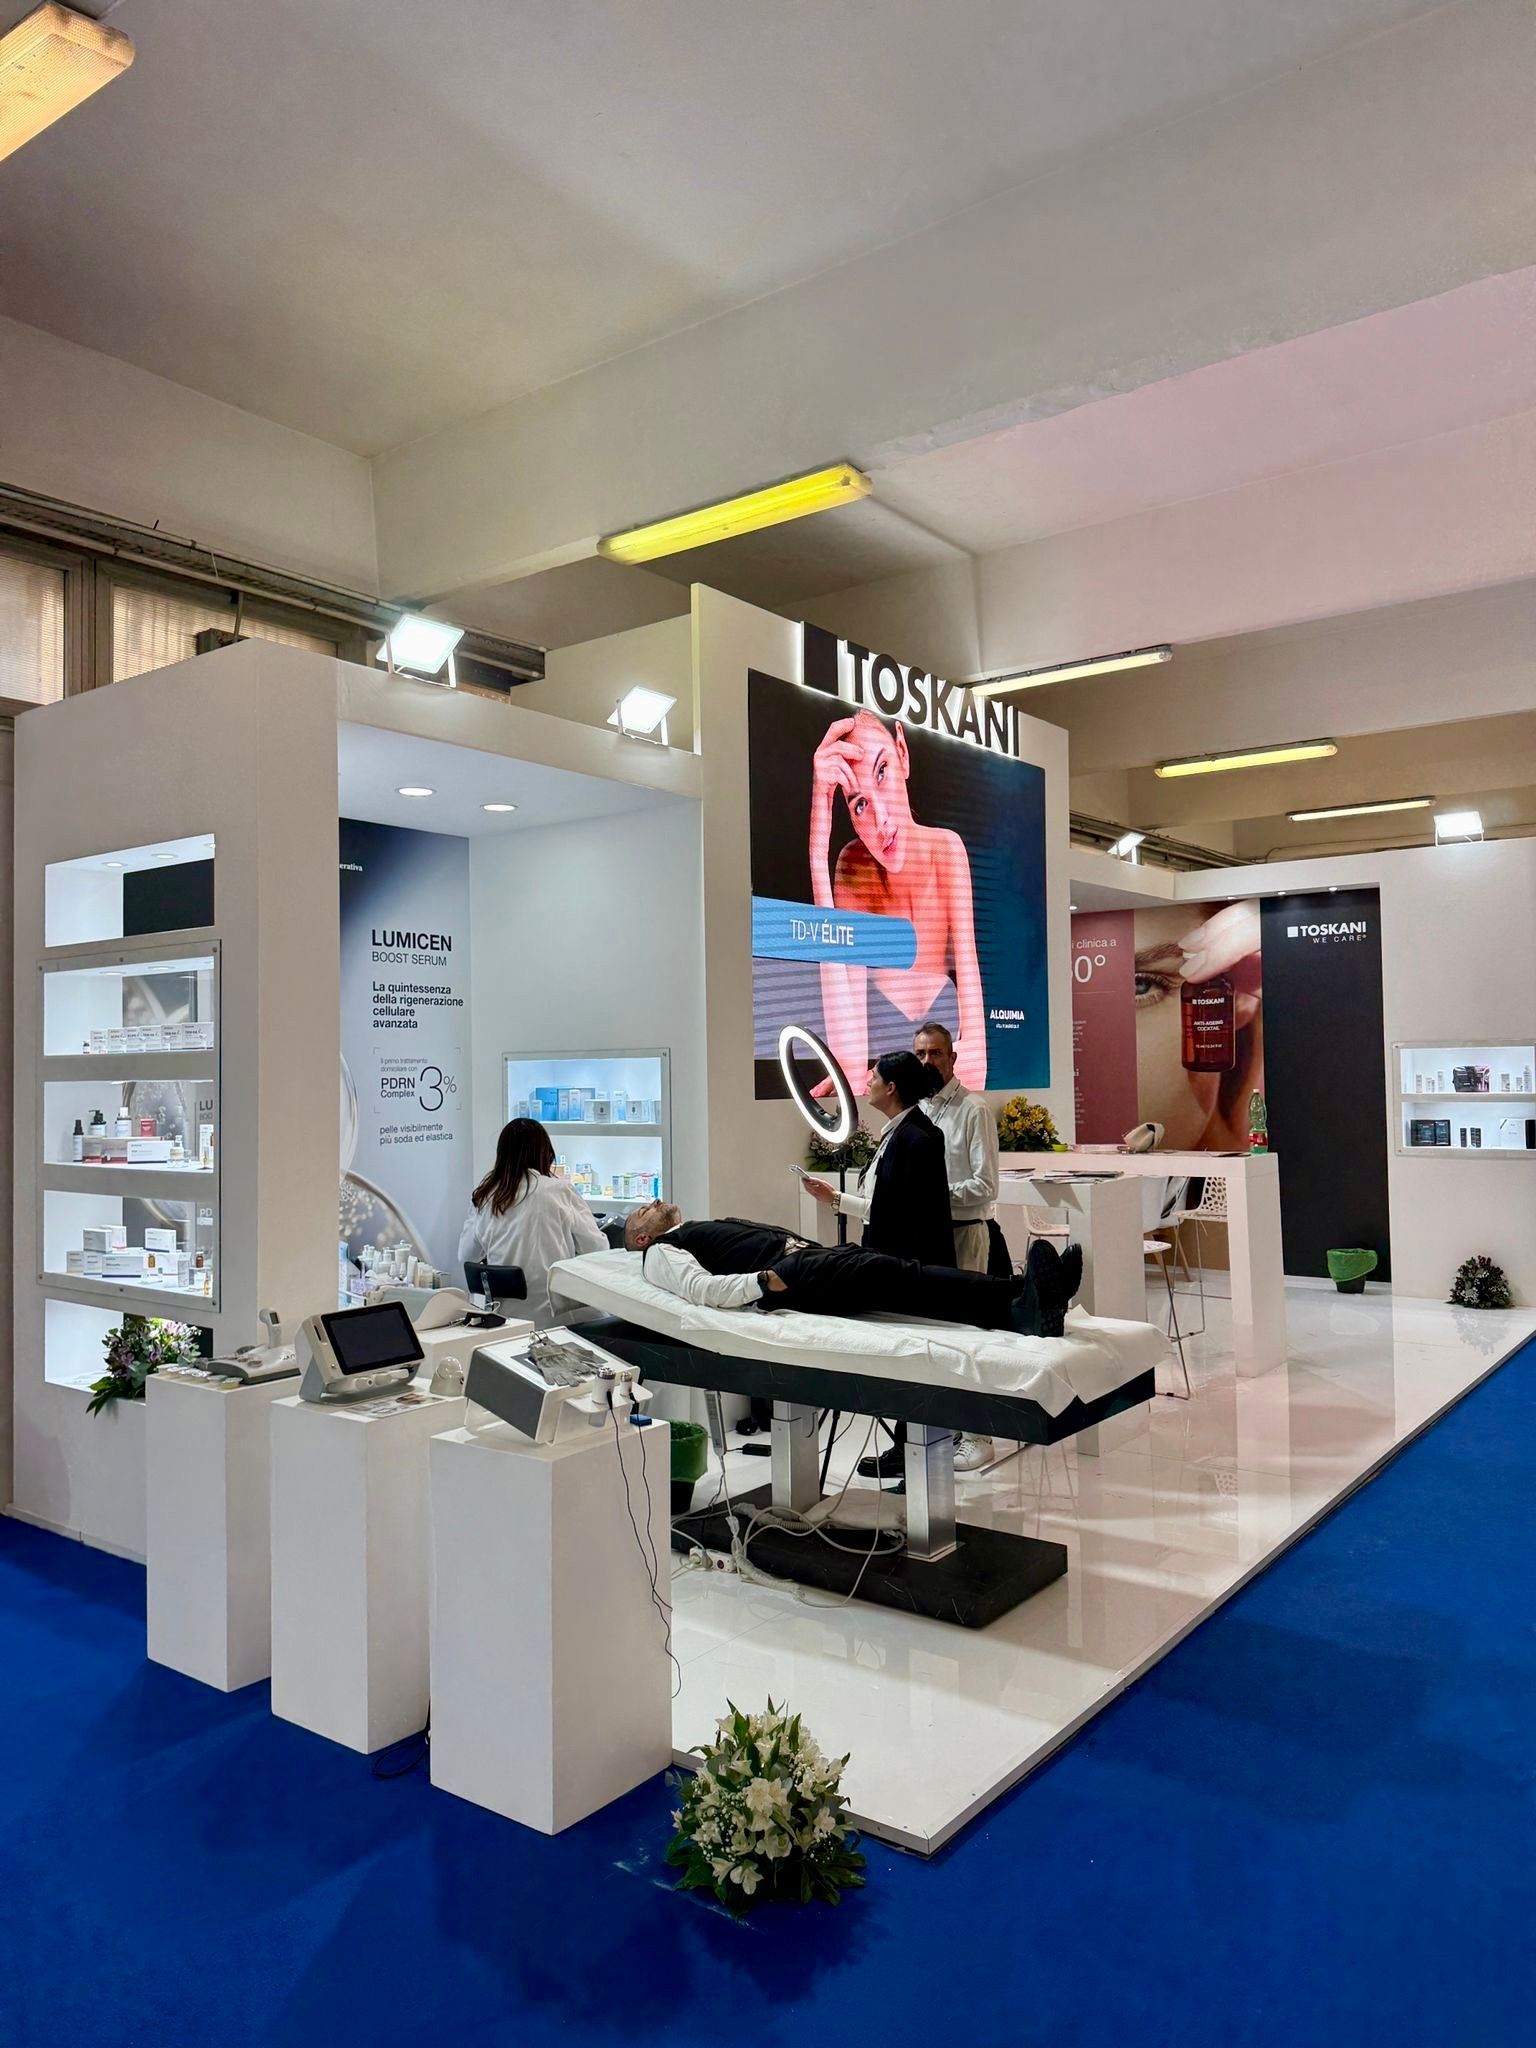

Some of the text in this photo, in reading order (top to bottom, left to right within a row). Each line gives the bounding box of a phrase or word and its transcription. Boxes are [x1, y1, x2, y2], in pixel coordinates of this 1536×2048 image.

[846, 639, 1020, 757] TOSKANI
[789, 918, 854, 946] TD-V ÉLITE
[1300, 921, 1367, 937] TOSKANI
[371, 929, 452, 952] LUMICEN
[1076, 938, 1107, 949] clinica
[1110, 938, 1117, 947] a
[1312, 936, 1327, 944] WE
[371, 951, 447, 966] BOOST SERUM
[372, 981, 451, 995] La quintessenza
[372, 993, 464, 1007] della rigenerazione
[1197, 997, 1225, 1005] TOSKANI
[372, 1005, 415, 1017] cellulare
[990, 1009, 1025, 1021] ALQUIMIA
[372, 1018, 418, 1029] avanzata
[381, 1077, 415, 1089] PDRN
[380, 1089, 415, 1099] Complex
[380, 1122, 443, 1135] pelle visibilmente
[380, 1131, 453, 1146] più soda ed elastica
